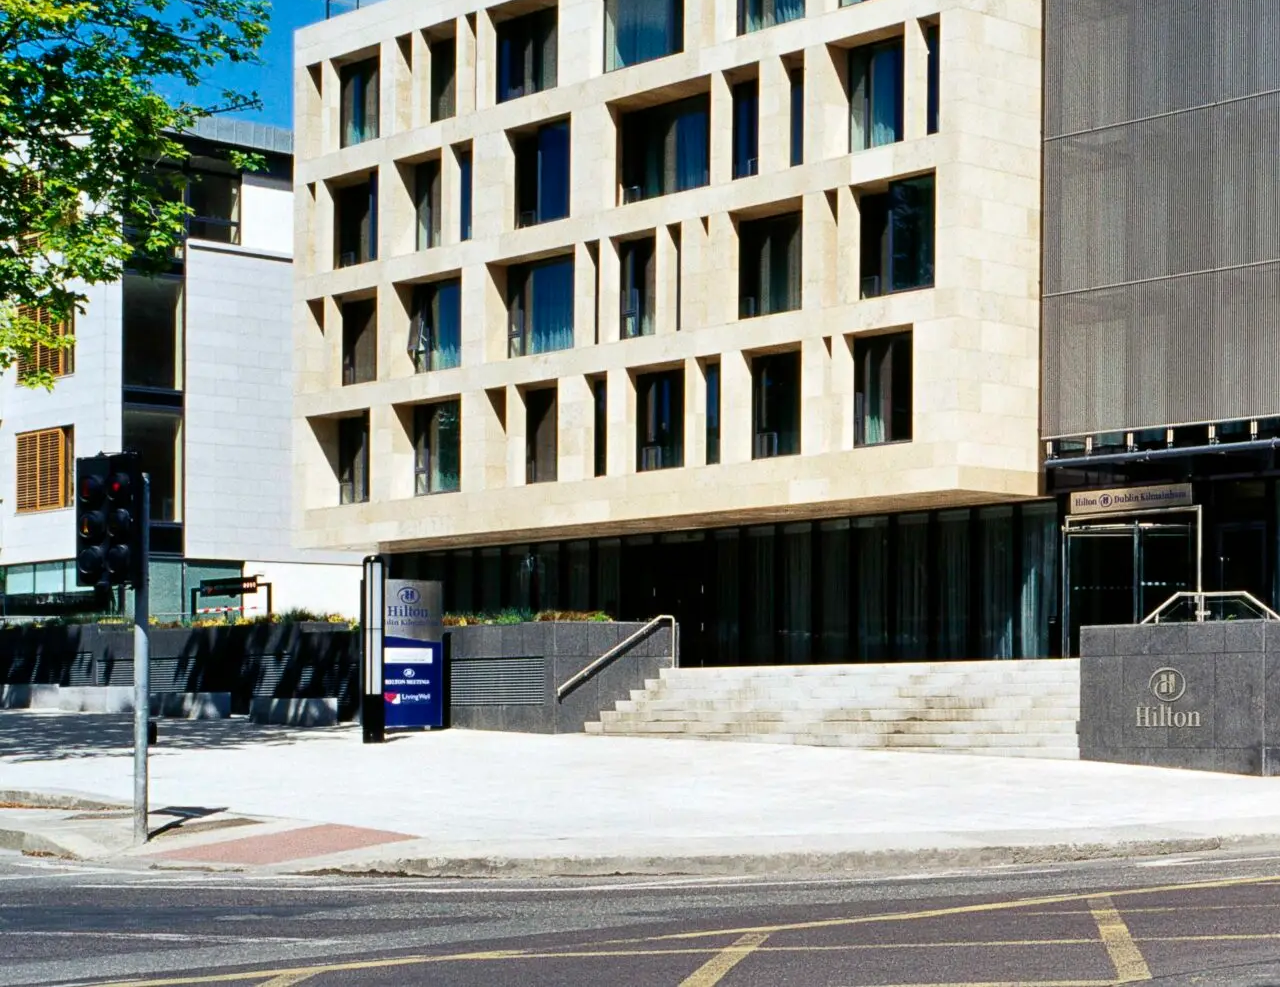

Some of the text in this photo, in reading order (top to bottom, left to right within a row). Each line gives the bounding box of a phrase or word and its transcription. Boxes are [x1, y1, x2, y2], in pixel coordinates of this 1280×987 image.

[1075, 497, 1097, 507] Hilton
[1114, 493, 1139, 504] Dublin
[387, 604, 428, 618] Hilton
[1135, 703, 1201, 728] Hilton
